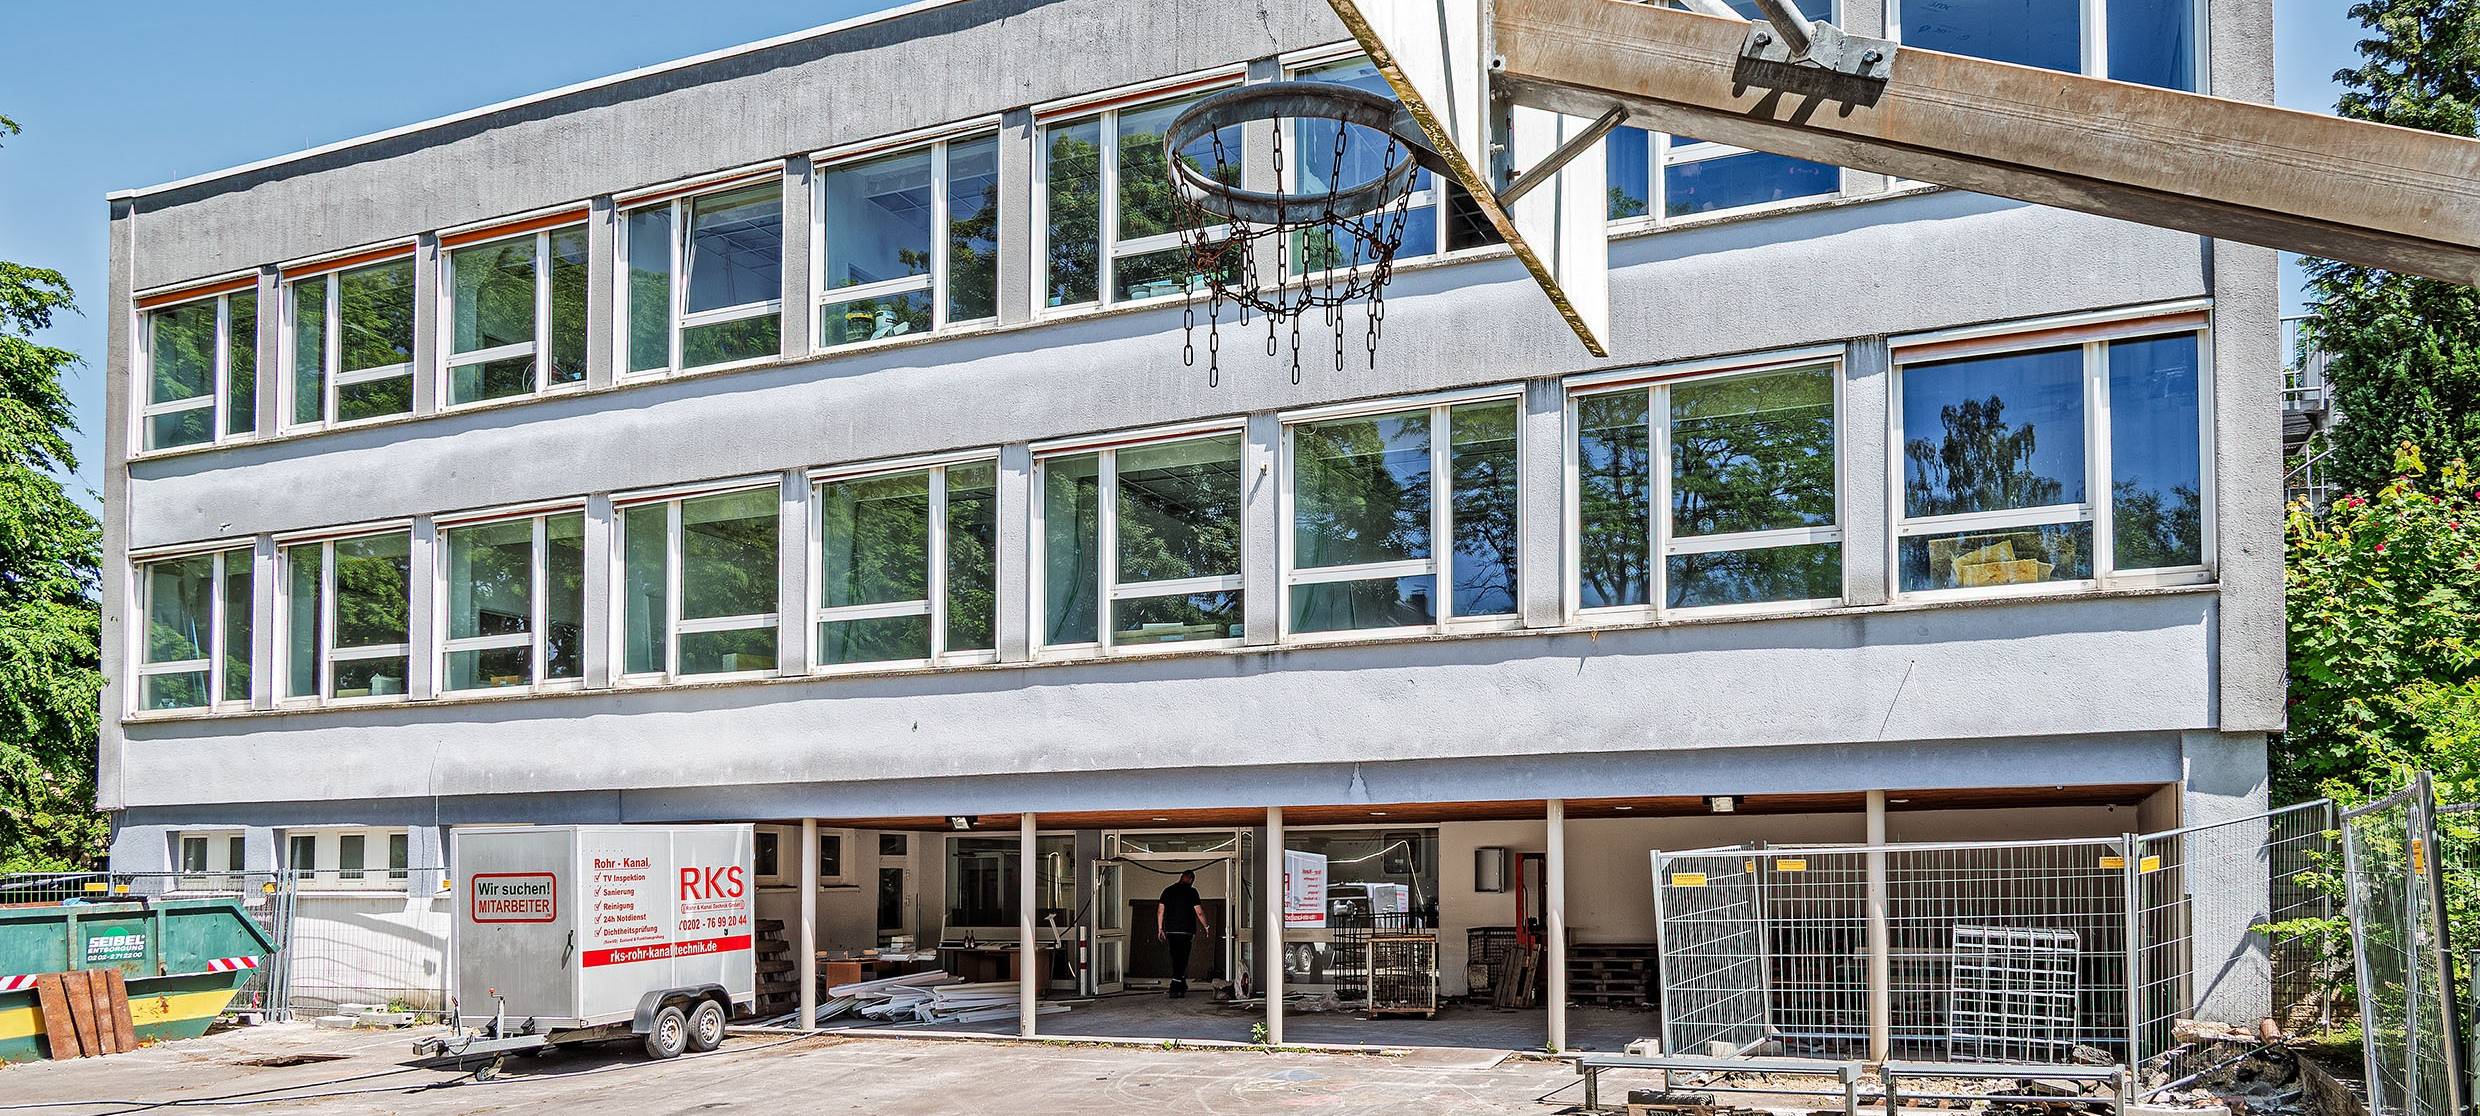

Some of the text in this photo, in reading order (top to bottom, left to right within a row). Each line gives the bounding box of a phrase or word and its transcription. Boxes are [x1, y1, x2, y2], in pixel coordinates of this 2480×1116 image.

[594, 858, 615, 868] Rohr
[614, 873, 646, 883] Inspektion
[680, 866, 745, 900] RKS
[478, 882, 550, 895] Wir suchen!
[603, 888, 634, 896] Sanierung
[478, 899, 550, 913] MITARBEITER
[603, 902, 634, 910] Reinigung
[603, 913, 647, 923] 24h Notdienst
[683, 919, 700, 930] 0202
[707, 917, 716, 928] 76
[718, 917, 727, 927] 99
[728, 916, 737, 926] 20
[739, 915, 747, 925] 44
[603, 925, 658, 936] Dichtheitsprüfung
[89, 935, 145, 948] SEIBEL
[88, 945, 144, 954] ENTSORGUNG
[610, 941, 717, 962] rks-rohr-kanaltechnik.de
